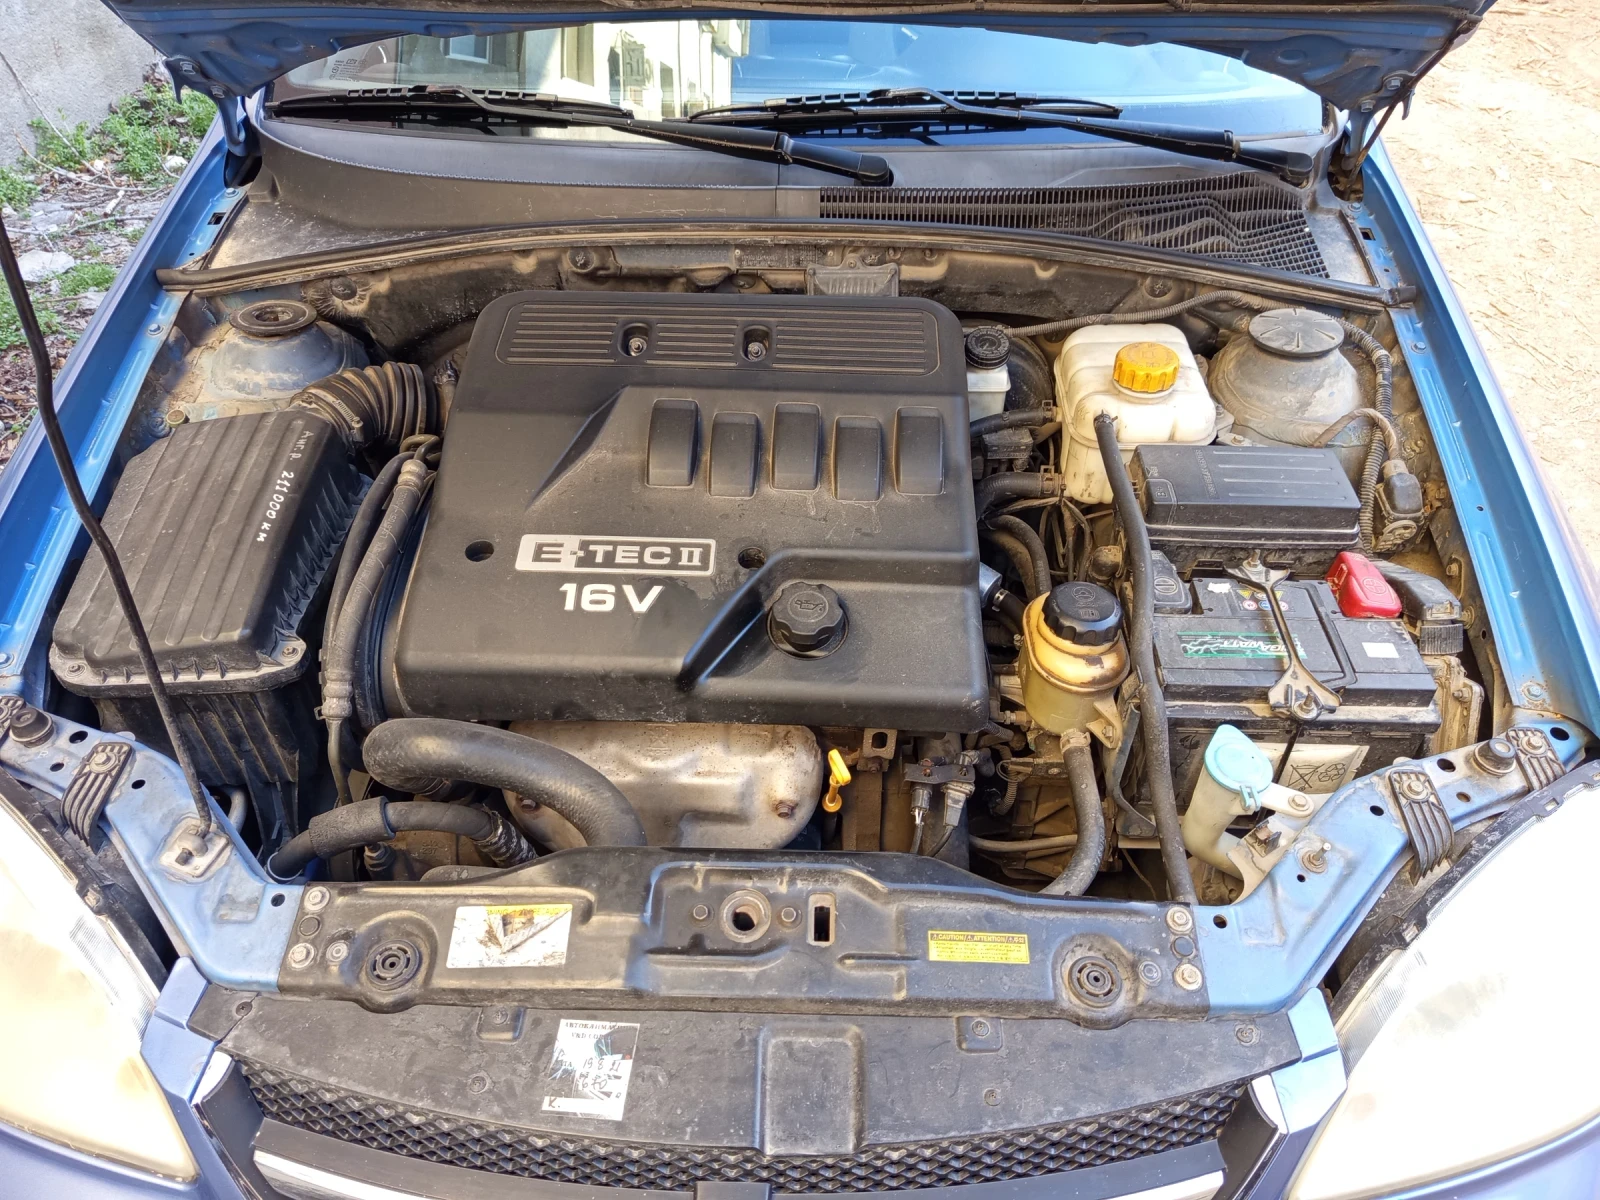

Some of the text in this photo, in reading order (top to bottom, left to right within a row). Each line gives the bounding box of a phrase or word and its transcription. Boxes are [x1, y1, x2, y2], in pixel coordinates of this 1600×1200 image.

[266, 470, 295, 519] 211000
[559, 582, 664, 613] 16V
[1221, 640, 1287, 652] IGAWATT
[973, 935, 1006, 943] ATTENTION
